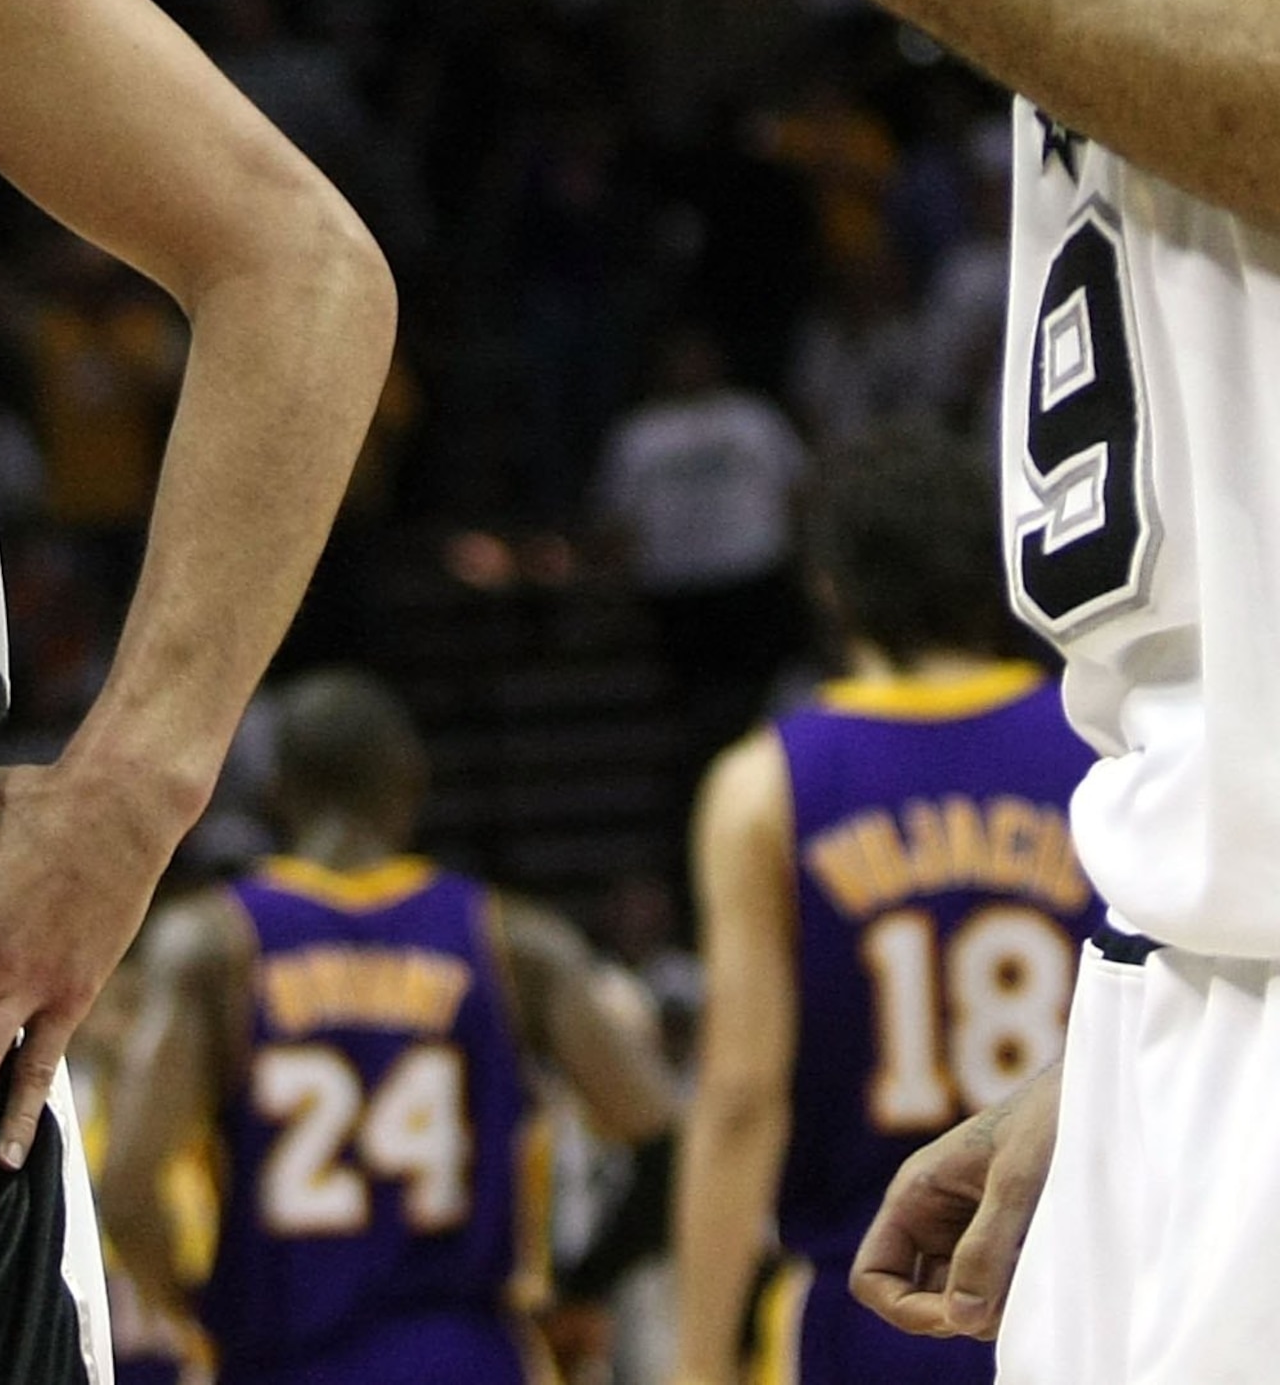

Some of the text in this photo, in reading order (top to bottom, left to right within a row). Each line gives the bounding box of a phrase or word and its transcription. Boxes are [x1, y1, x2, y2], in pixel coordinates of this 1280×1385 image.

[1012, 194, 1164, 647] 9
[860, 906, 1074, 1132] 18
[250, 1044, 469, 1236] 24
